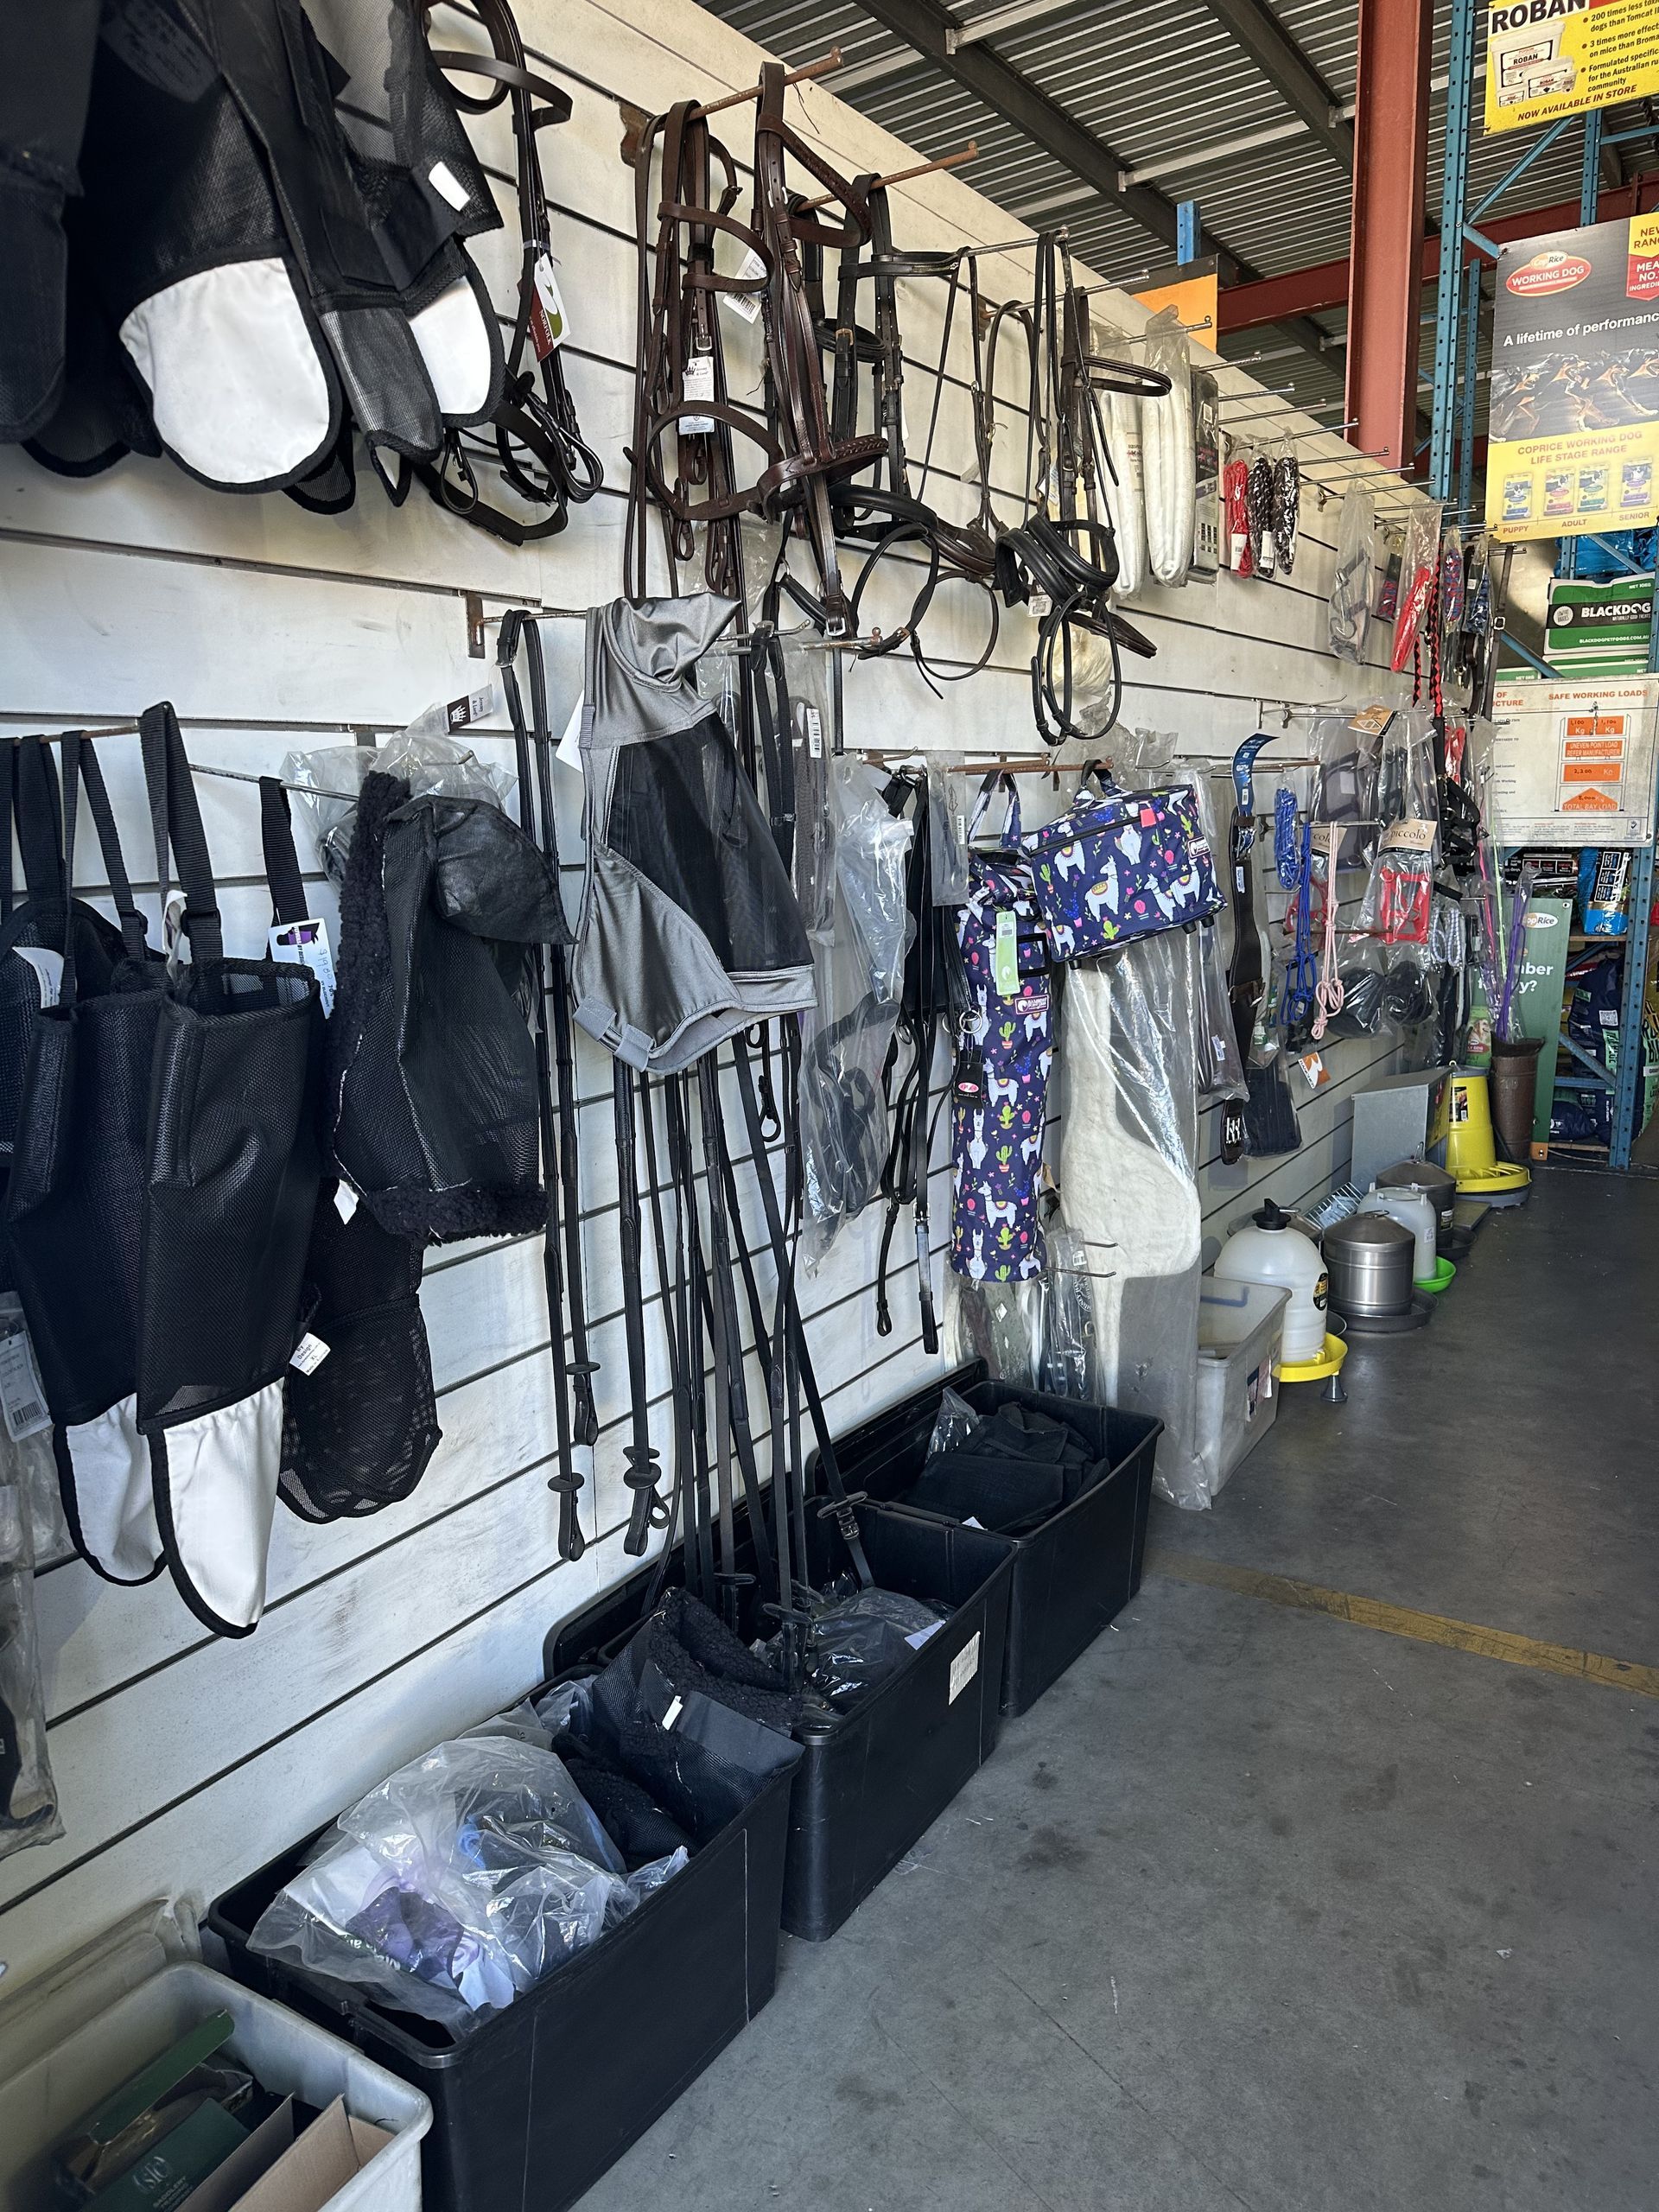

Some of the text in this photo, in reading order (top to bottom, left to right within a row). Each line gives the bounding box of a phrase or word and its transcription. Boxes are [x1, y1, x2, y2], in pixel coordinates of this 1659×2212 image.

[1492, 0, 1586, 34] ROBAN
[1591, 11, 1605, 22] 200
[1607, 7, 1626, 17] times
[1629, 3, 1642, 12] less
[1591, 22, 1607, 32] dogs
[1609, 18, 1624, 27] than
[1626, 9, 1653, 22] Tomcat
[1596, 35, 1616, 46] times
[1618, 30, 1636, 41] more
[1599, 46, 1617, 55] mice
[1618, 41, 1635, 50] than
[1513, 54, 1538, 66] ROBAN
[1589, 55, 1629, 73] Formulated
[1599, 71, 1611, 79] the
[1612, 61, 1649, 76] Australian
[1587, 77, 1626, 92] community
[1517, 85, 1637, 121] NOW AVAILABLE IN STORE
[1634, 238, 1659, 249] RAN
[1512, 266, 1585, 286] WORKING DOG
[539, 308, 552, 346] NORFOLK
[1503, 335, 1513, 346] A
[1516, 329, 1563, 345] lifetime
[1567, 324, 1580, 336] of
[1517, 430, 1643, 455] COPRICE WORKING DOG
[1530, 444, 1627, 465] LIFE STAGE RANGE
[1561, 518, 1587, 528] ADULT
[1619, 511, 1649, 522] SENIOR
[1503, 525, 1529, 534] PUPPY
[1581, 602, 1651, 618] BLACKDOG
[1580, 635, 1649, 644] BLACKDOGPETFOODS.COM.AU
[1575, 727, 1586, 735] Kg
[1605, 726, 1616, 734] Kg
[1390, 830, 1426, 841] piccolo
[1523, 917, 1554, 926] opRice
[297, 1344, 312, 1360] Design
[153, 2176, 186, 2208] SADDLERY
